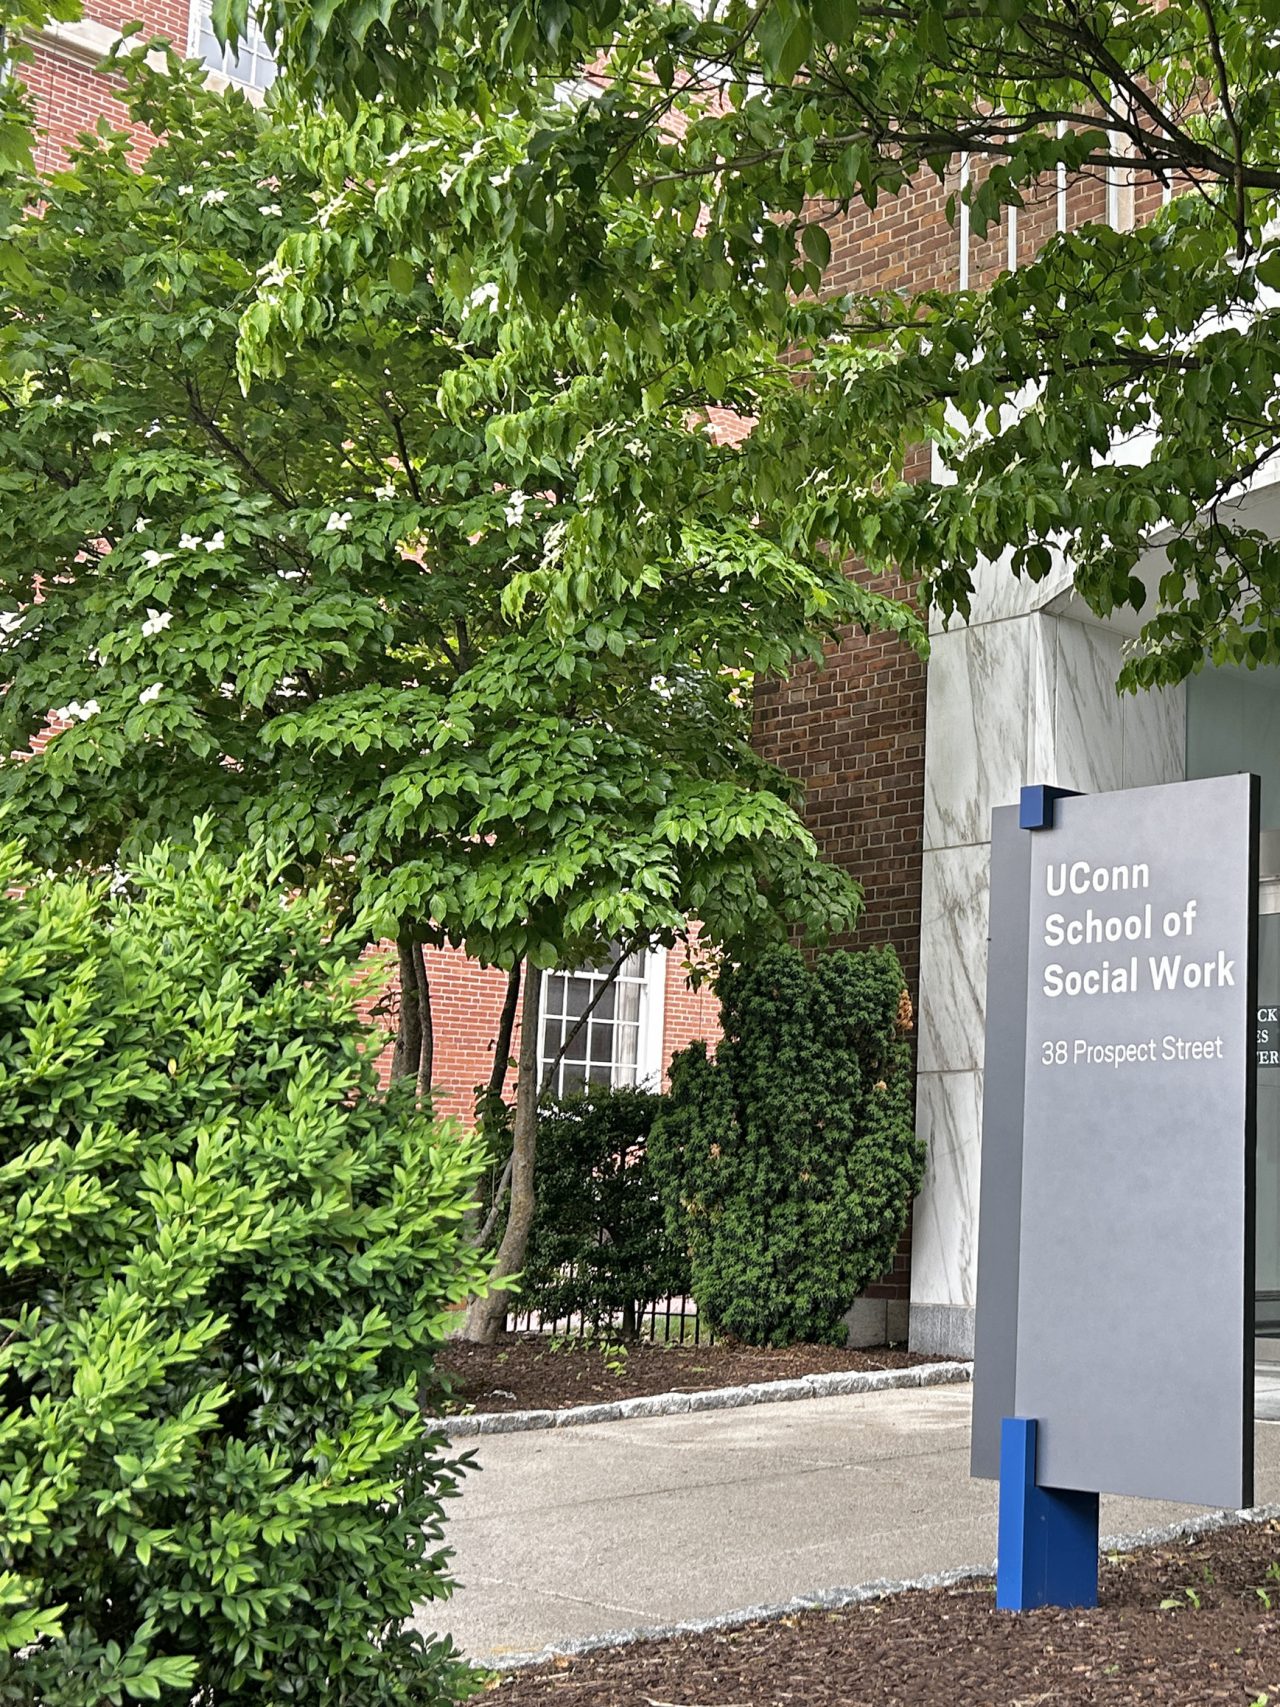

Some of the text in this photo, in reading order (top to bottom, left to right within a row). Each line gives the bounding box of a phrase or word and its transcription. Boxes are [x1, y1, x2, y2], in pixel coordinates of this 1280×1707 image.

[1046, 861, 1149, 897] UConn
[1044, 900, 1197, 947] School of
[1043, 950, 1236, 997] Social Work
[1041, 1035, 1223, 1069] 38 Prospect Street
[1257, 1050, 1279, 1065] ER
